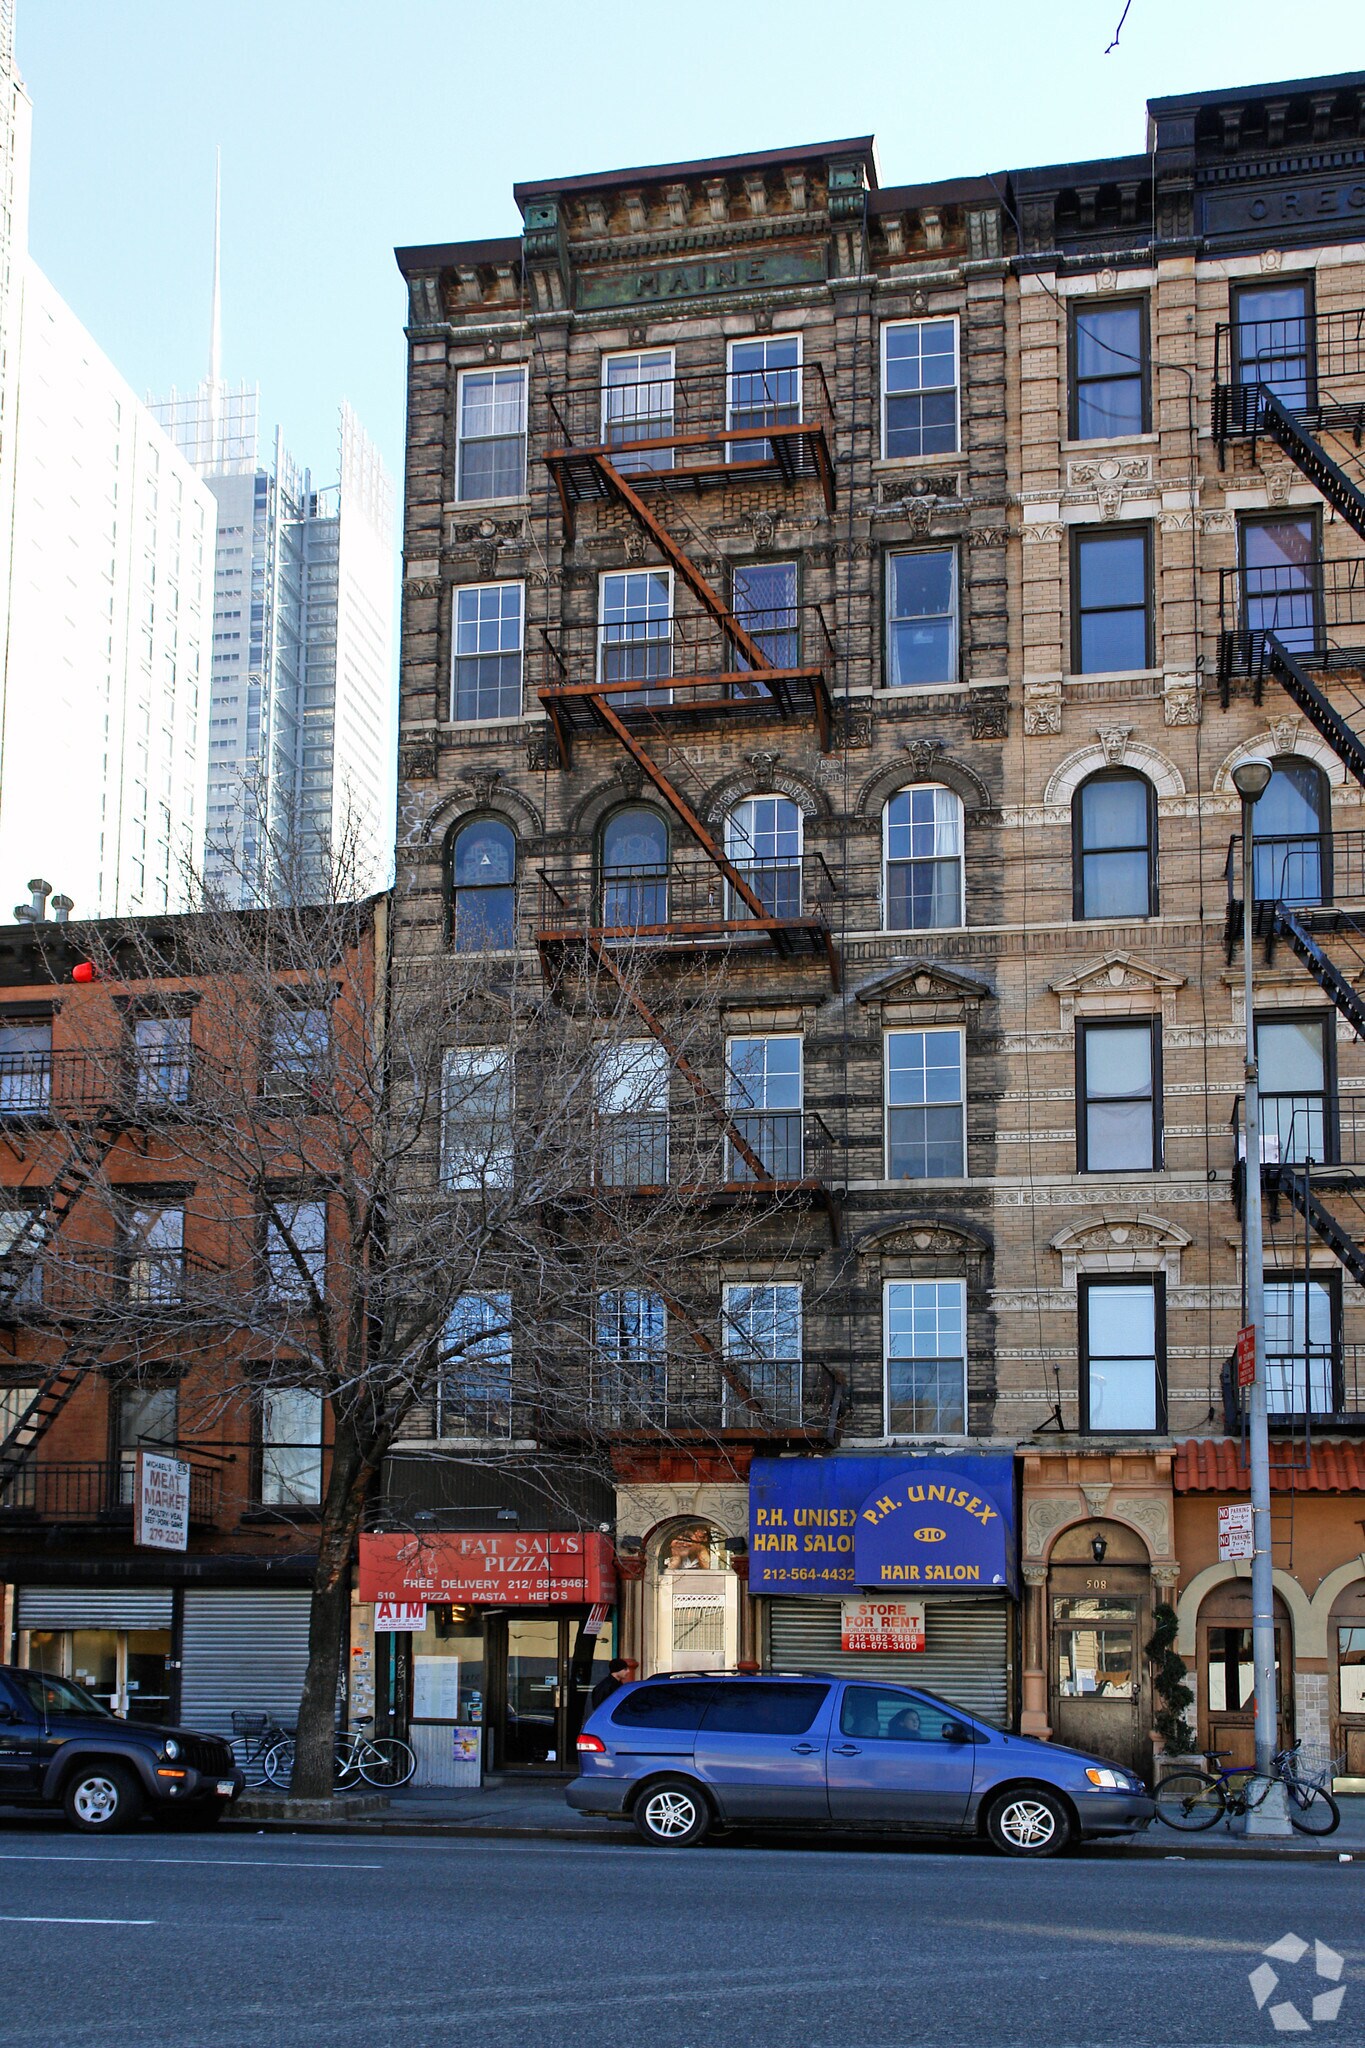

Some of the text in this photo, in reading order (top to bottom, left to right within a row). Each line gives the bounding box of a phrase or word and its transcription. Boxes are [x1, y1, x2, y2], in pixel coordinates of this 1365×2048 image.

[636, 260, 766, 296] MAINE
[150, 1470, 182, 1492] MEAT
[144, 1488, 187, 1511] MARKET
[907, 1485, 998, 1526] UNISEX
[756, 1508, 788, 1526] P.H.
[1220, 1507, 1250, 1518] NO PARKING
[918, 1530, 942, 1540] 510
[1220, 1533, 1250, 1546] NO PARKING
[460, 1537, 579, 1554] FAT SAL'S
[753, 1534, 855, 1552] HAIR SALO
[484, 1556, 553, 1572] PIZZA
[763, 1568, 855, 1580] 212-564-4432
[880, 1565, 921, 1580] HAIR
[924, 1565, 980, 1580] SALON
[403, 1580, 434, 1588] FREE
[441, 1580, 500, 1589] DELIVERY
[536, 1578, 589, 1589] 594-9462
[1086, 1579, 1107, 1590] 508
[377, 1591, 396, 1600] 510
[420, 1592, 451, 1600] PIZZA
[471, 1592, 507, 1600] PASTA
[377, 1602, 425, 1618] ATM
[858, 1604, 907, 1615] STORE
[845, 1616, 920, 1627] FOR RENT
[848, 1634, 917, 1642] 212-982-2888
[848, 1642, 918, 1650] 646-675-3400
